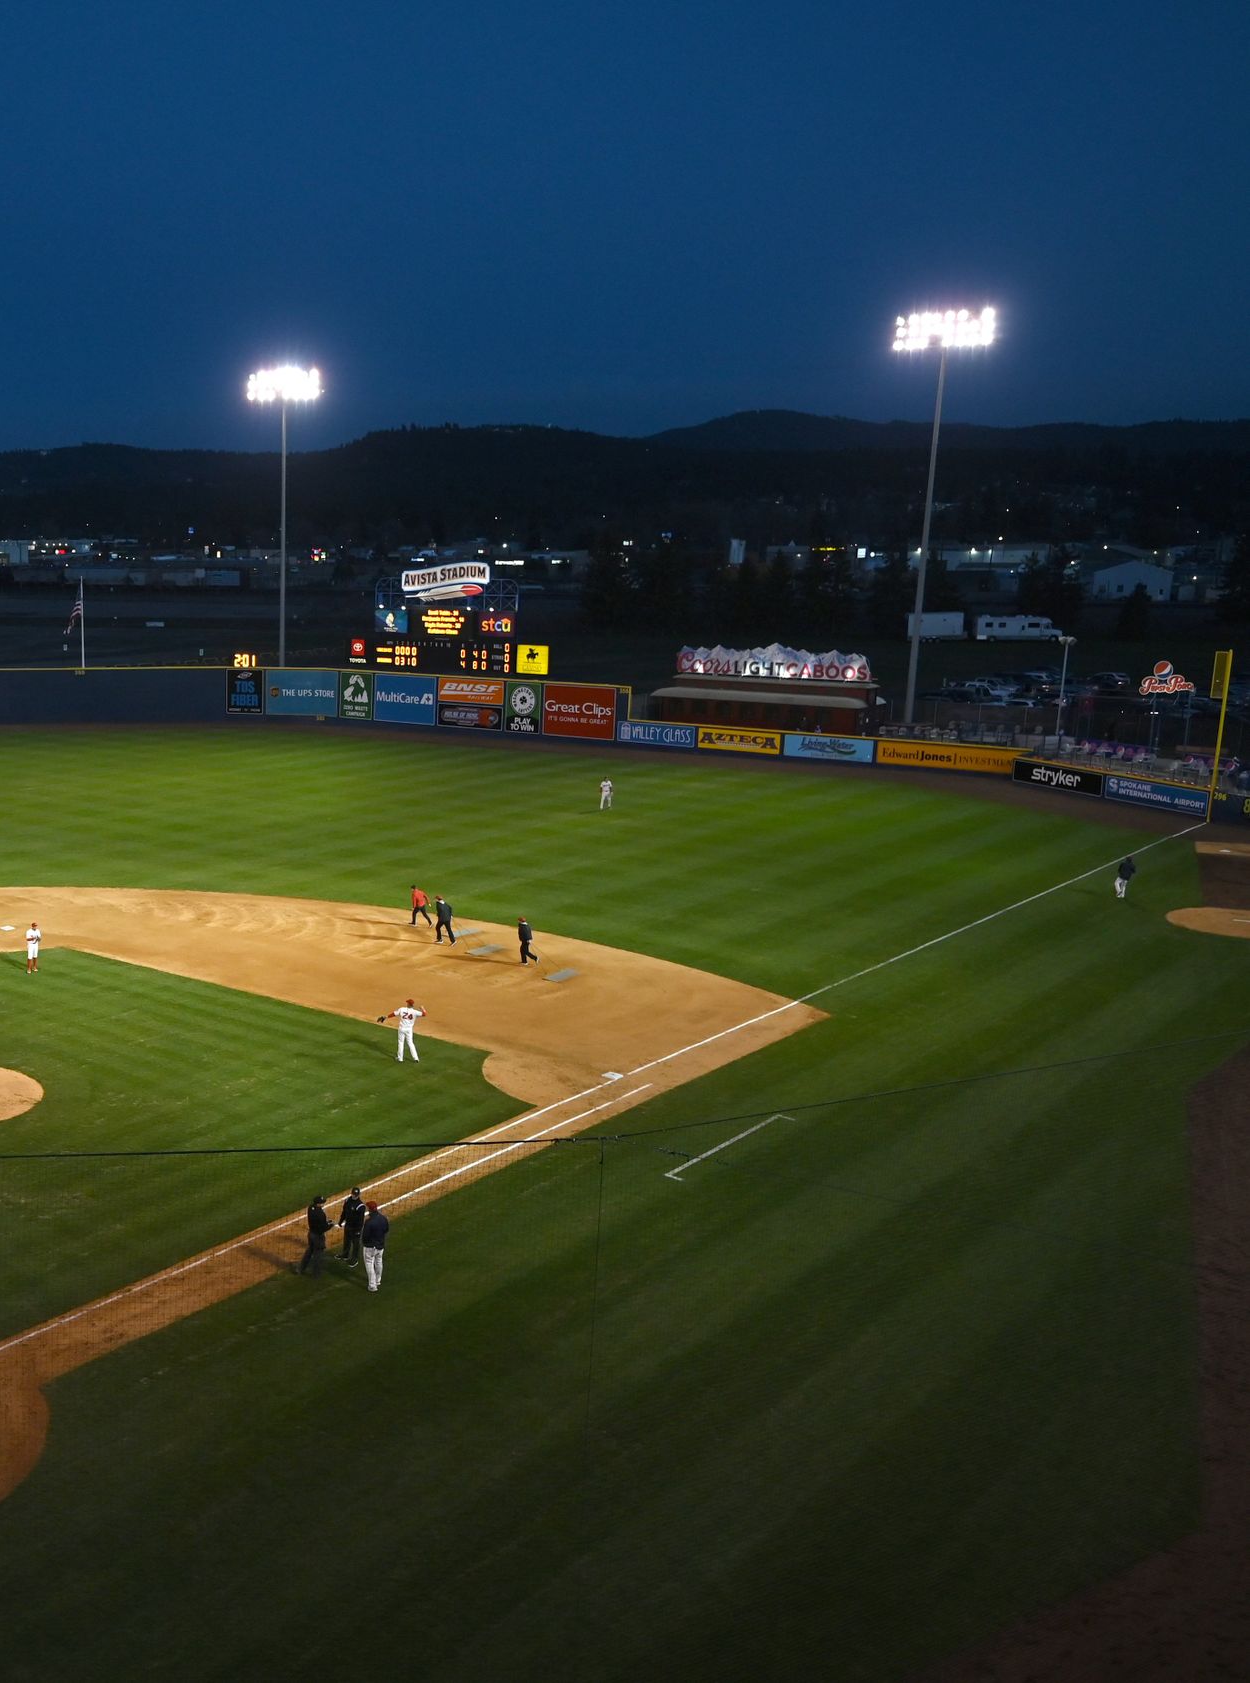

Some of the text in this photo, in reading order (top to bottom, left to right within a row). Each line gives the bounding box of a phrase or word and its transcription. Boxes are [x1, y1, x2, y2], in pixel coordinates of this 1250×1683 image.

[403, 565, 487, 587] AVISTA STADIUM
[481, 617, 511, 632] stcu
[234, 653, 256, 668] 2:01
[676, 650, 732, 674] Coors
[734, 660, 785, 676] LIGHT
[234, 680, 255, 693] TDS
[281, 688, 335, 698] THE UPS STORE
[443, 681, 503, 693] BNSF
[230, 694, 259, 706] FIBER
[376, 690, 420, 705] MultiCare
[545, 699, 612, 718] Great Clips
[514, 717, 531, 725] PLAY
[559, 715, 579, 723] GONNA
[510, 723, 535, 732] TO WIN
[632, 724, 692, 744] VALLEY GLASS
[700, 731, 779, 750] AZTECA
[882, 747, 919, 760] Edward
[919, 750, 952, 763] Jones
[1030, 766, 1081, 788] stryker
[1118, 779, 1151, 793] SPOKANE
[1118, 787, 1205, 810] INTERNATIONAL AIRPORT
[401, 1011, 414, 1021] 24
